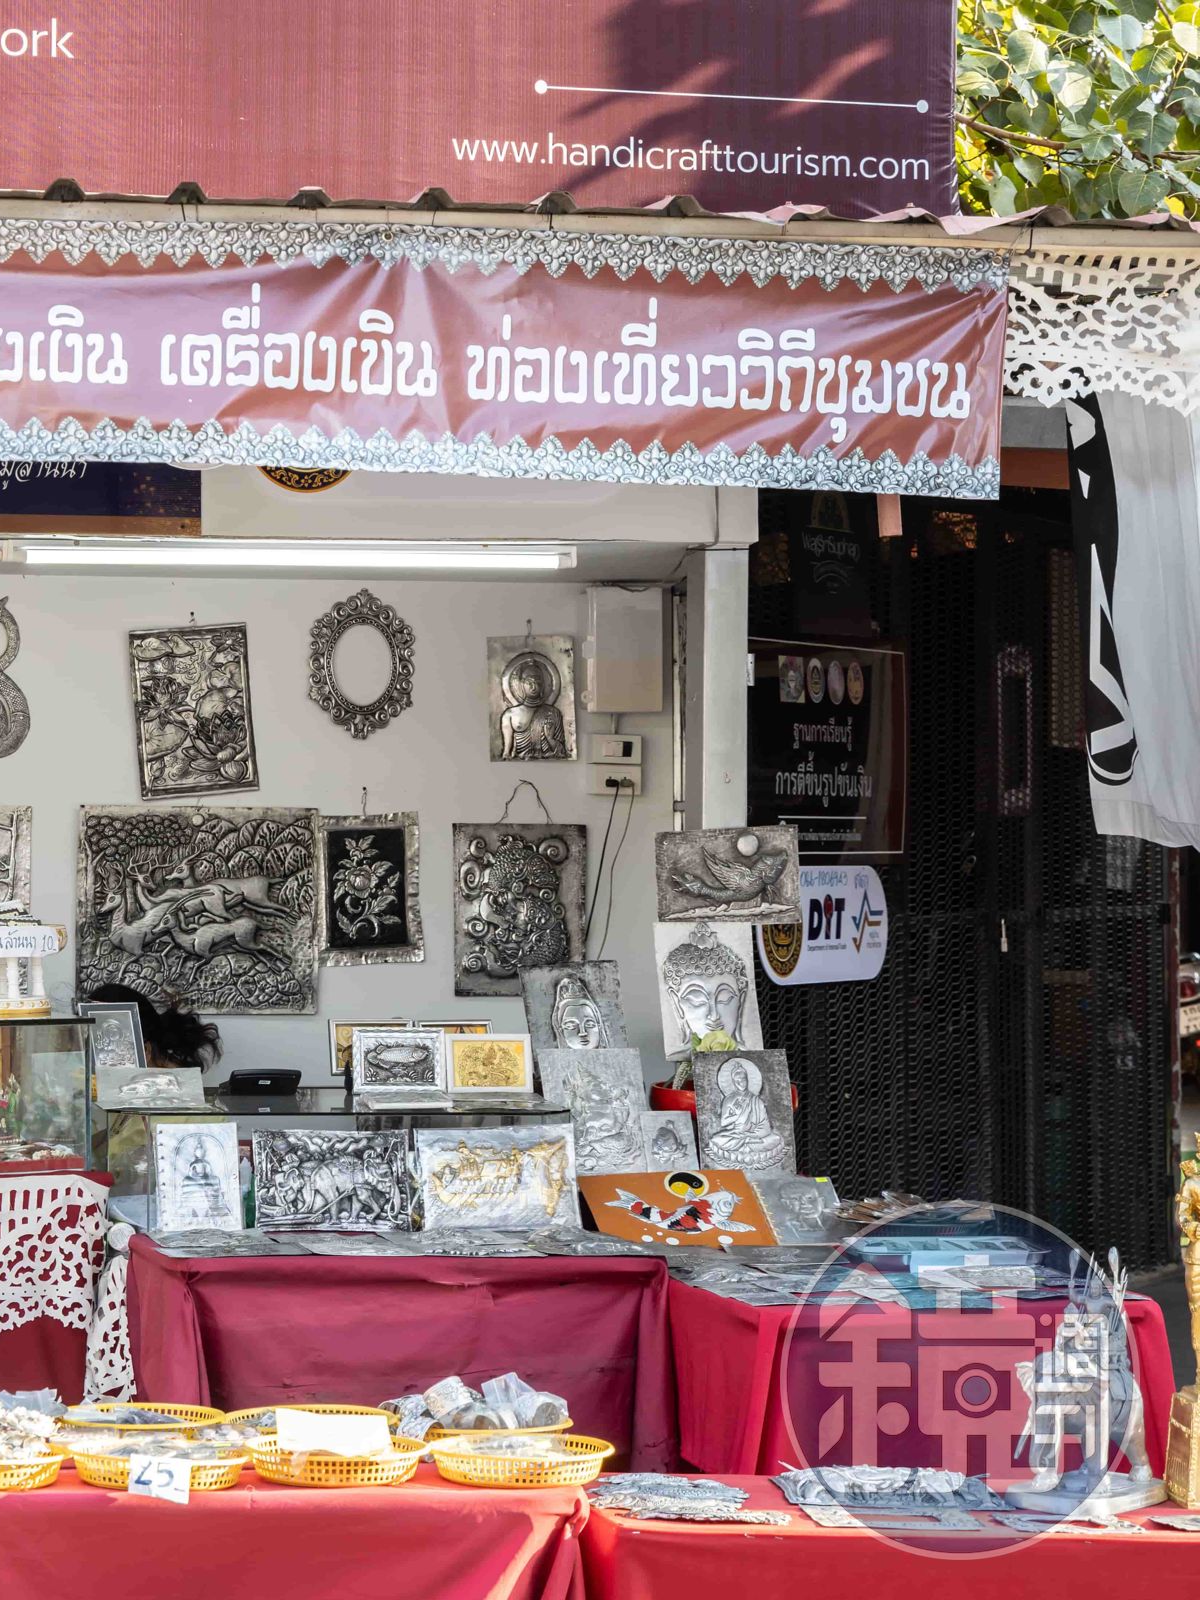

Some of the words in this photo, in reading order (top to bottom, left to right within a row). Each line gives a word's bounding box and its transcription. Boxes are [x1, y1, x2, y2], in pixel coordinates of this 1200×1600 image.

[451, 132, 931, 182] www.handicrafttourism.com
[160, 282, 438, 397] เครื่องเขิน
[466, 297, 971, 443] ท่องเที่ยววิถีชุมชน
